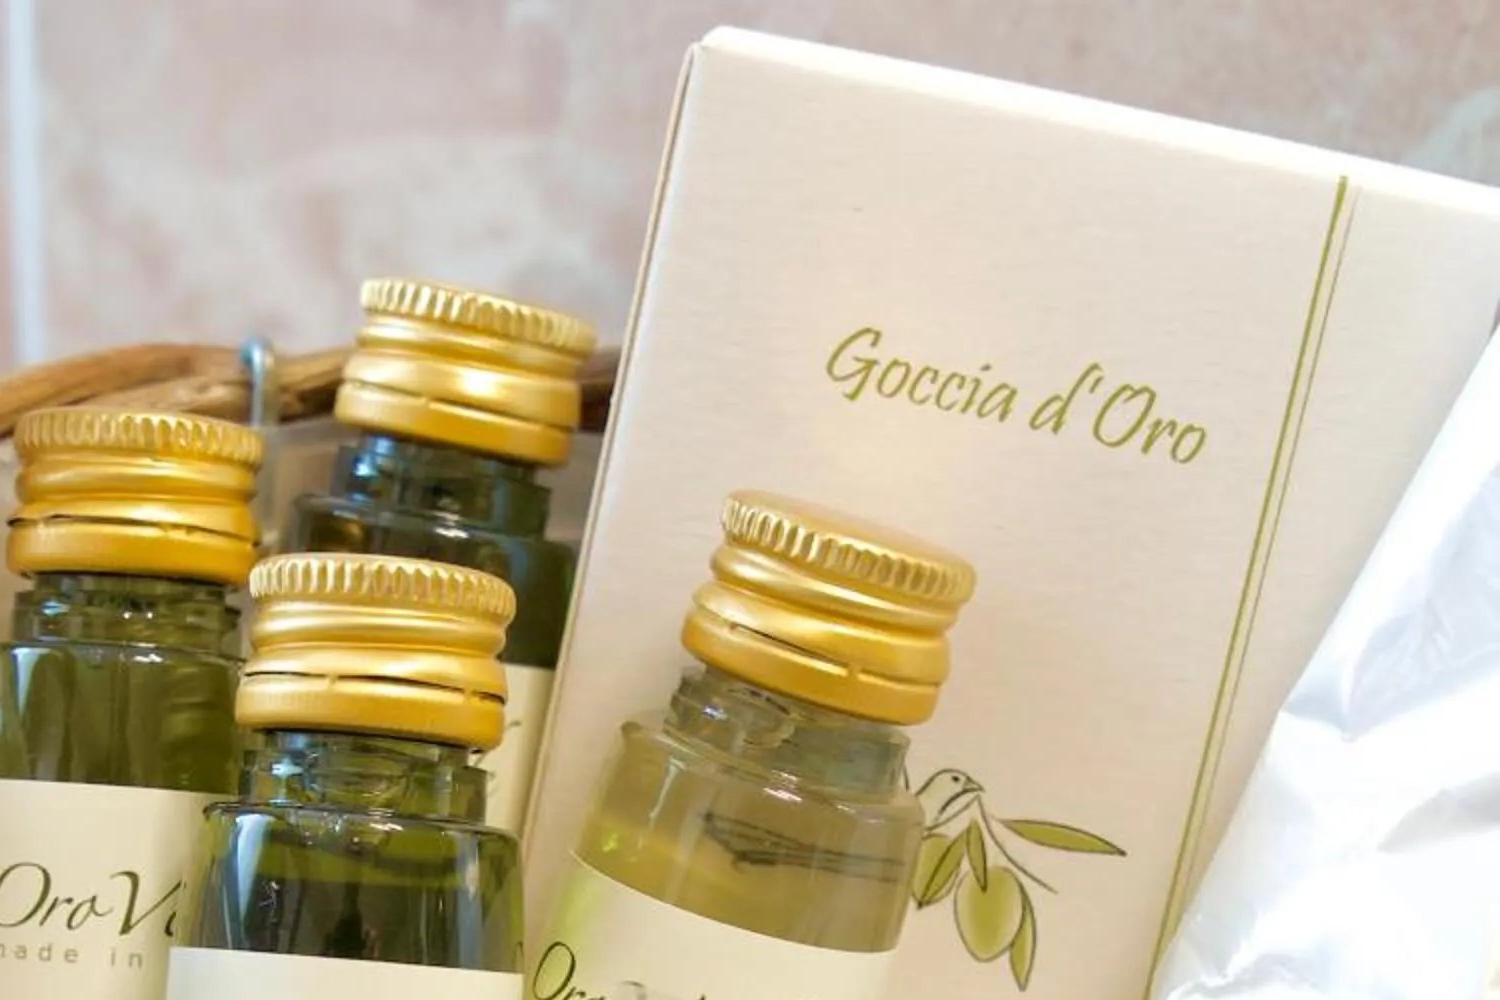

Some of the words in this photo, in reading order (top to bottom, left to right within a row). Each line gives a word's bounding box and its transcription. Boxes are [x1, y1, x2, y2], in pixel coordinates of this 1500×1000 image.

[825, 326, 1018, 423] Goccia
[1028, 362, 1208, 465] d'Oro
[110, 946, 144, 970] in
